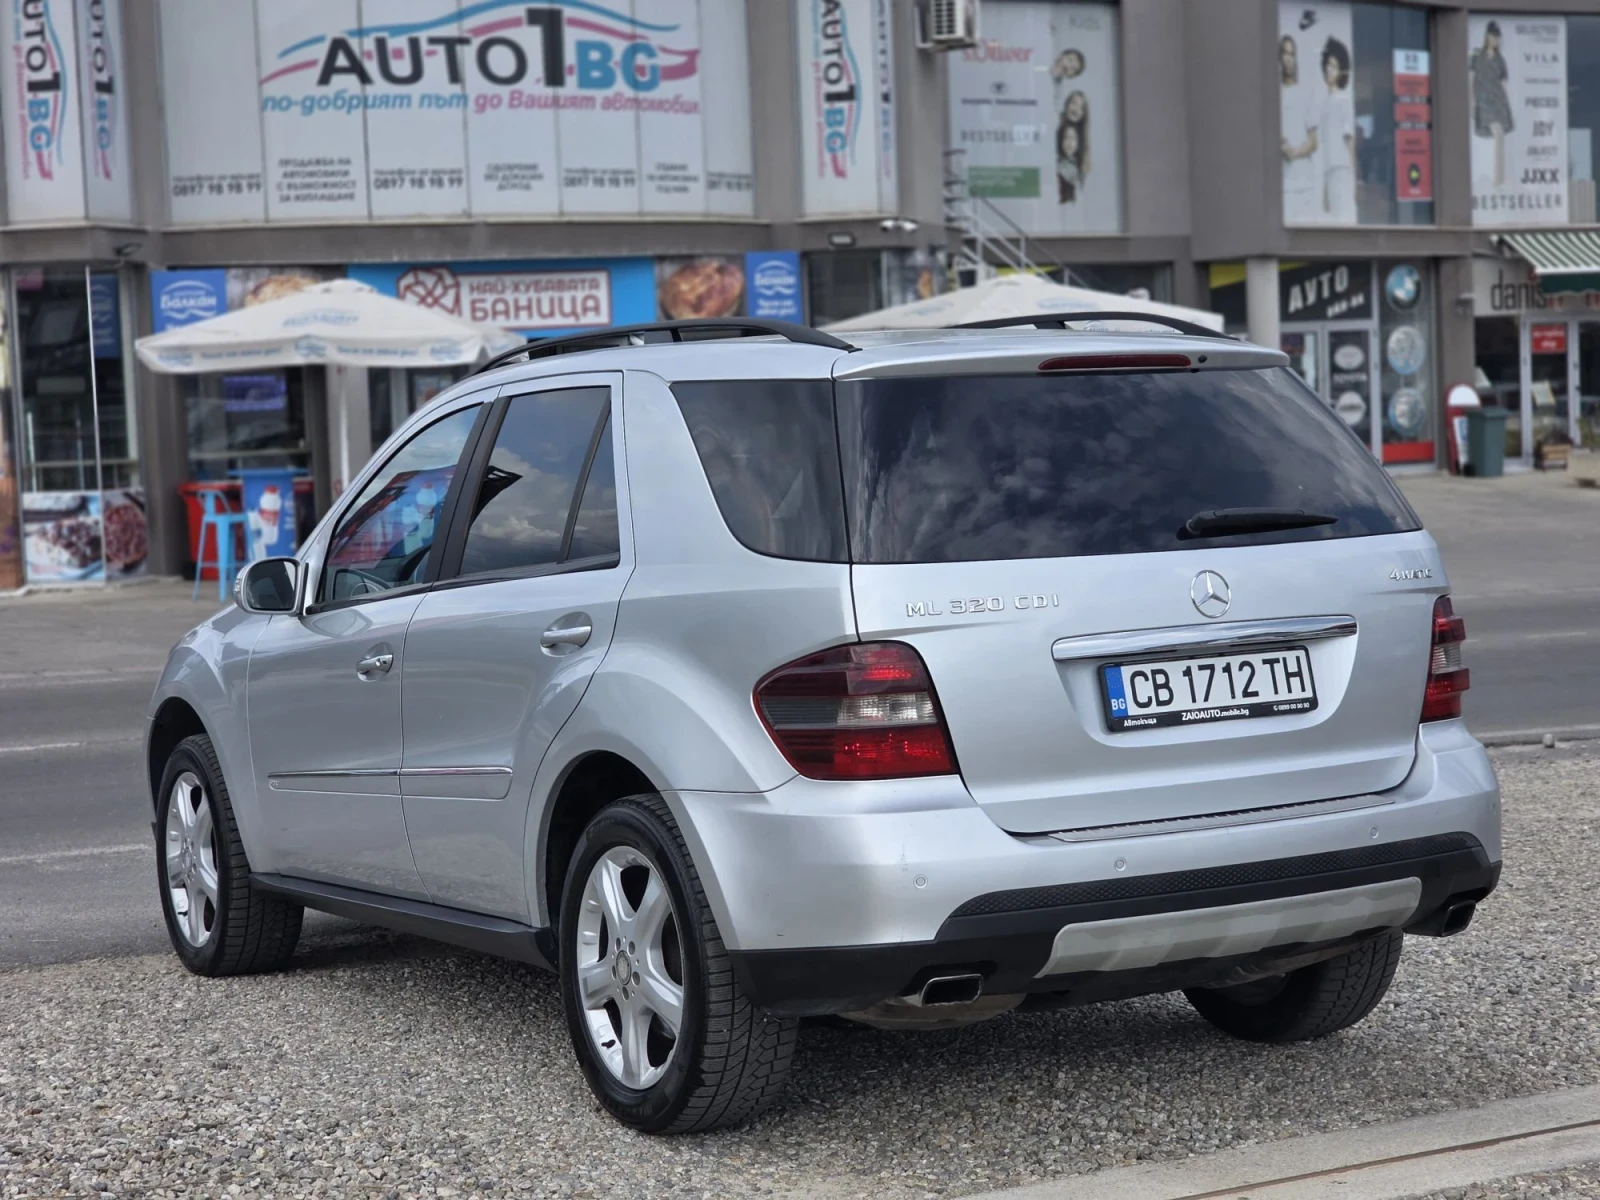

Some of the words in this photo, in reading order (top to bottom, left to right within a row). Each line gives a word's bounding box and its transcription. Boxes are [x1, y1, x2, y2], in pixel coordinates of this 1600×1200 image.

[262, 88, 413, 116] по-добрият
[419, 92, 469, 110] път
[474, 92, 502, 114] до
[508, 90, 597, 110] Вашият
[1521, 168, 1559, 184] JJXX
[470, 293, 601, 322] БАНИЦА
[906, 599, 943, 617] ML
[950, 596, 1005, 614] 320
[1014, 593, 1060, 610] CDI
[1129, 668, 1174, 709] CB
[1182, 660, 1259, 703] 1712
[1261, 655, 1307, 695] TH
[1111, 698, 1126, 711] BG
